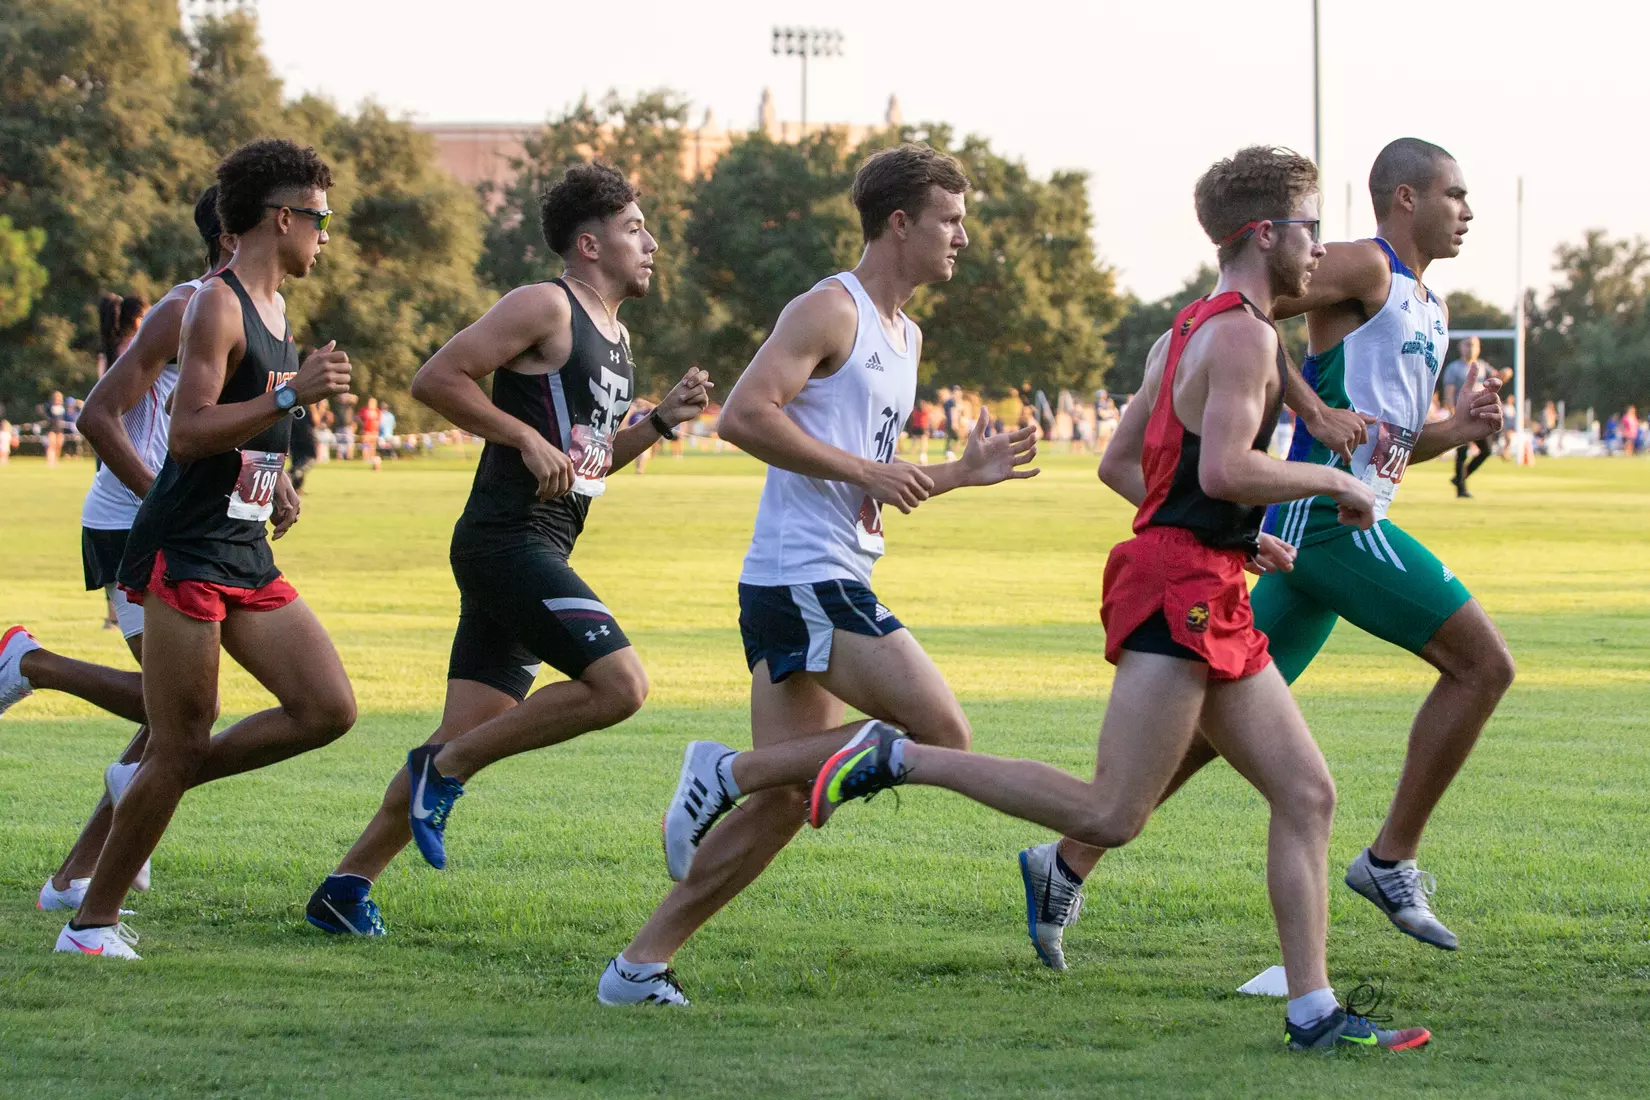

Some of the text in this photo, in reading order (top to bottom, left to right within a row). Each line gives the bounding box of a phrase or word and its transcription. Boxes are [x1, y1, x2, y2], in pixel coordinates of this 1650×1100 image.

[865, 362, 884, 372] adidas
[578, 444, 606, 477] 228
[1380, 444, 1411, 481] 221
[249, 469, 278, 502] 199
